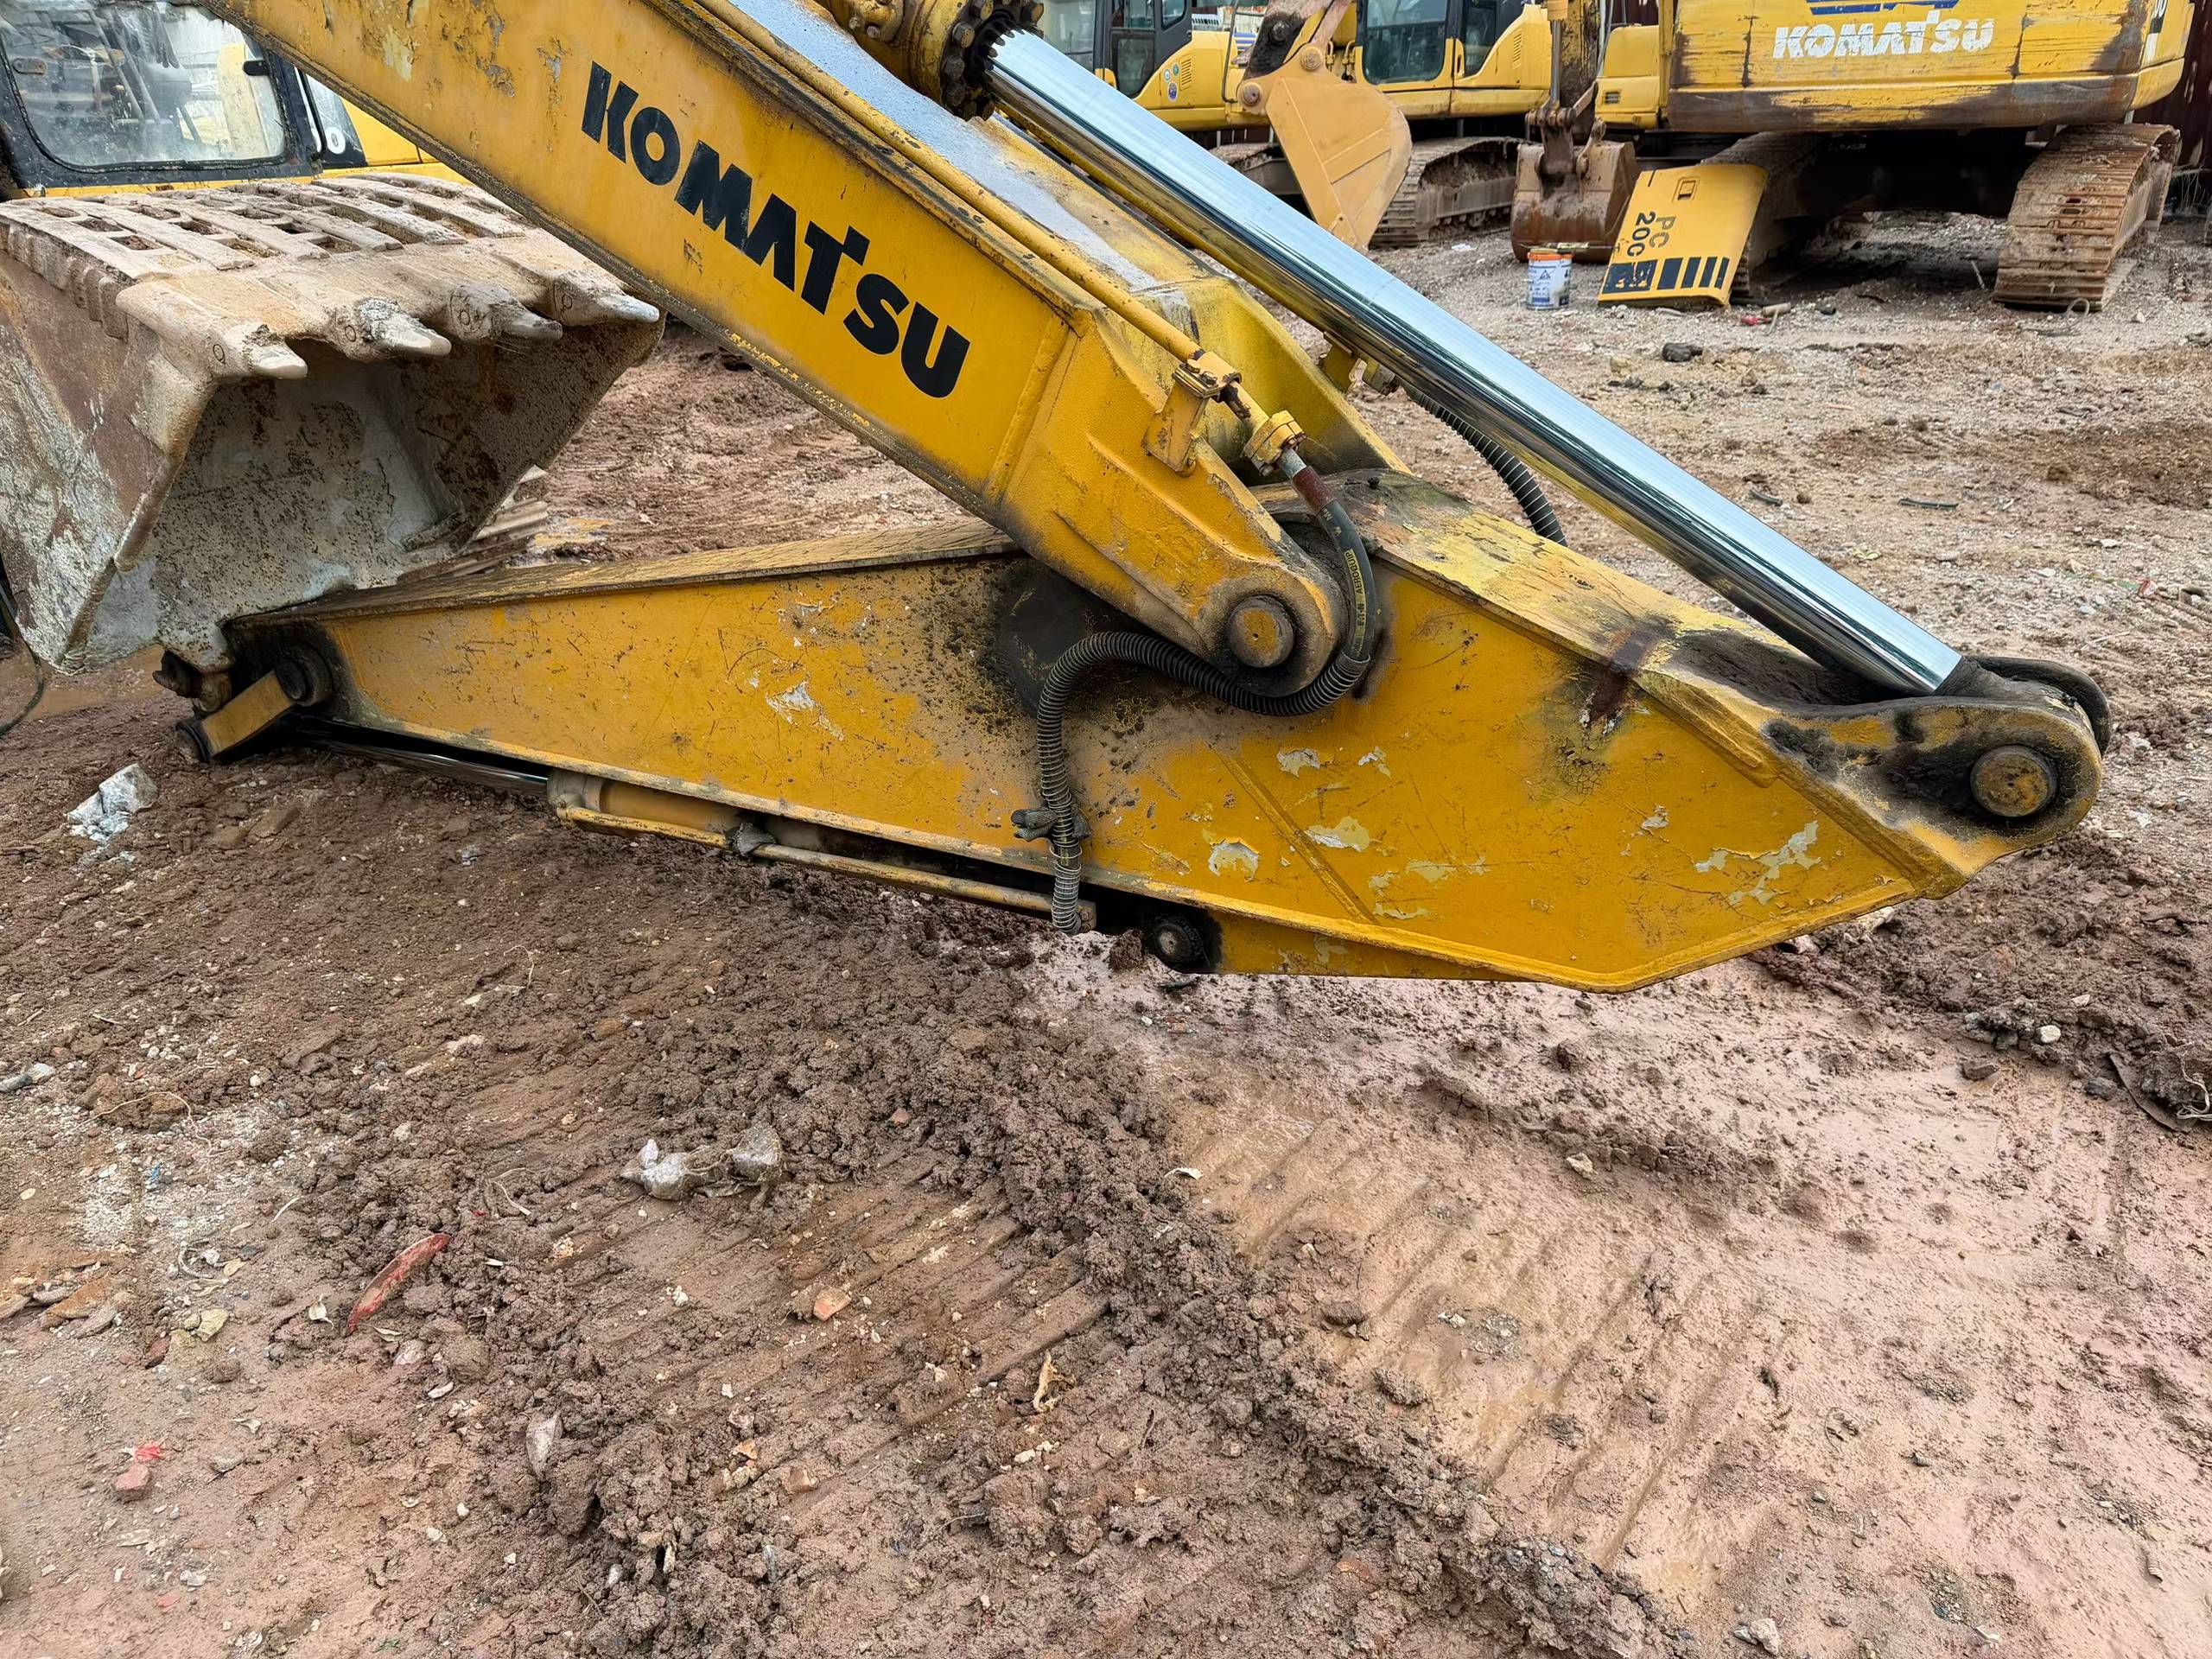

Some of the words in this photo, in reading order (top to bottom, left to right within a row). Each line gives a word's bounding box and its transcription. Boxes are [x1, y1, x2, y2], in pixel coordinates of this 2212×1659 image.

[1772, 10, 1995, 59] KOMATSU
[582, 60, 970, 398] KOMATSU
[1649, 216, 1677, 249] PC
[1344, 550, 1363, 594] AEROQUIP
